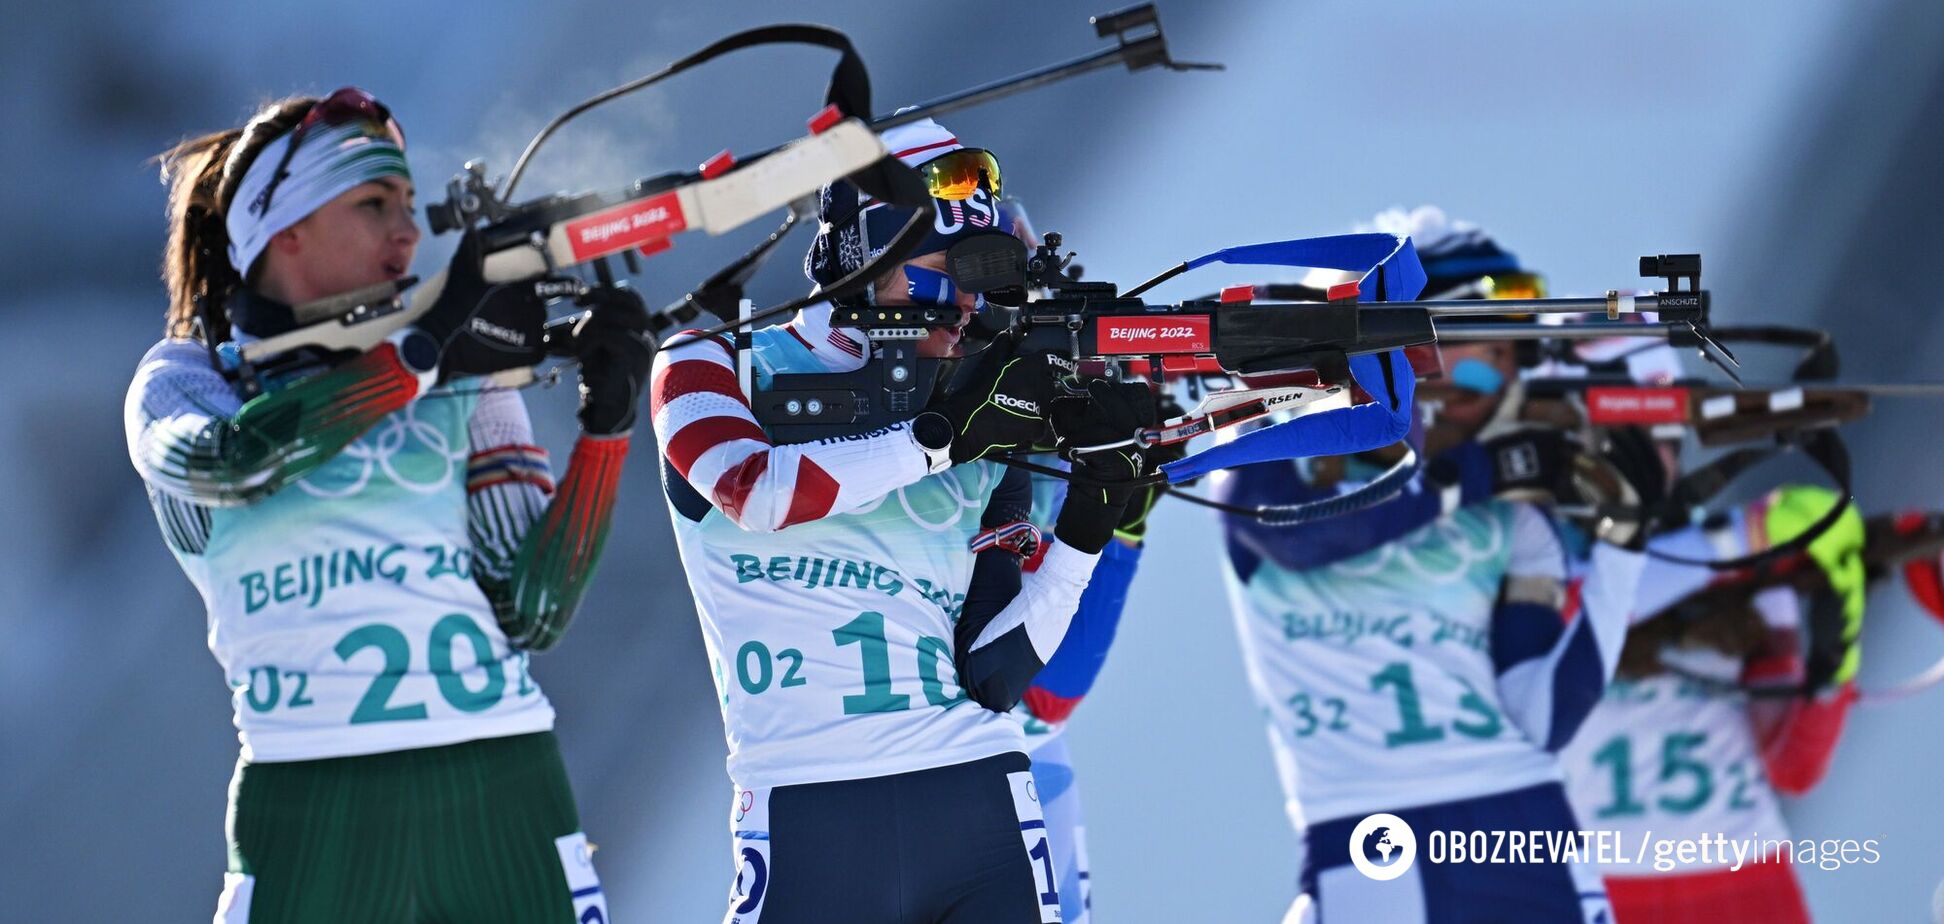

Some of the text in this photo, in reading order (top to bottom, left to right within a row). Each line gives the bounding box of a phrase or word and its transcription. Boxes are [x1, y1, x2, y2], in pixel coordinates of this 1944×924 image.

[1110, 327, 1196, 342] BEIJING 2022
[994, 393, 1040, 415] ROECK
[1264, 392, 1303, 407] RSEN
[239, 543, 471, 614] BEIJING 20
[730, 554, 904, 596] BEIJING
[333, 613, 506, 725] 20
[832, 610, 970, 715] 10
[1370, 662, 1503, 748] 13
[1592, 733, 1715, 819] 15
